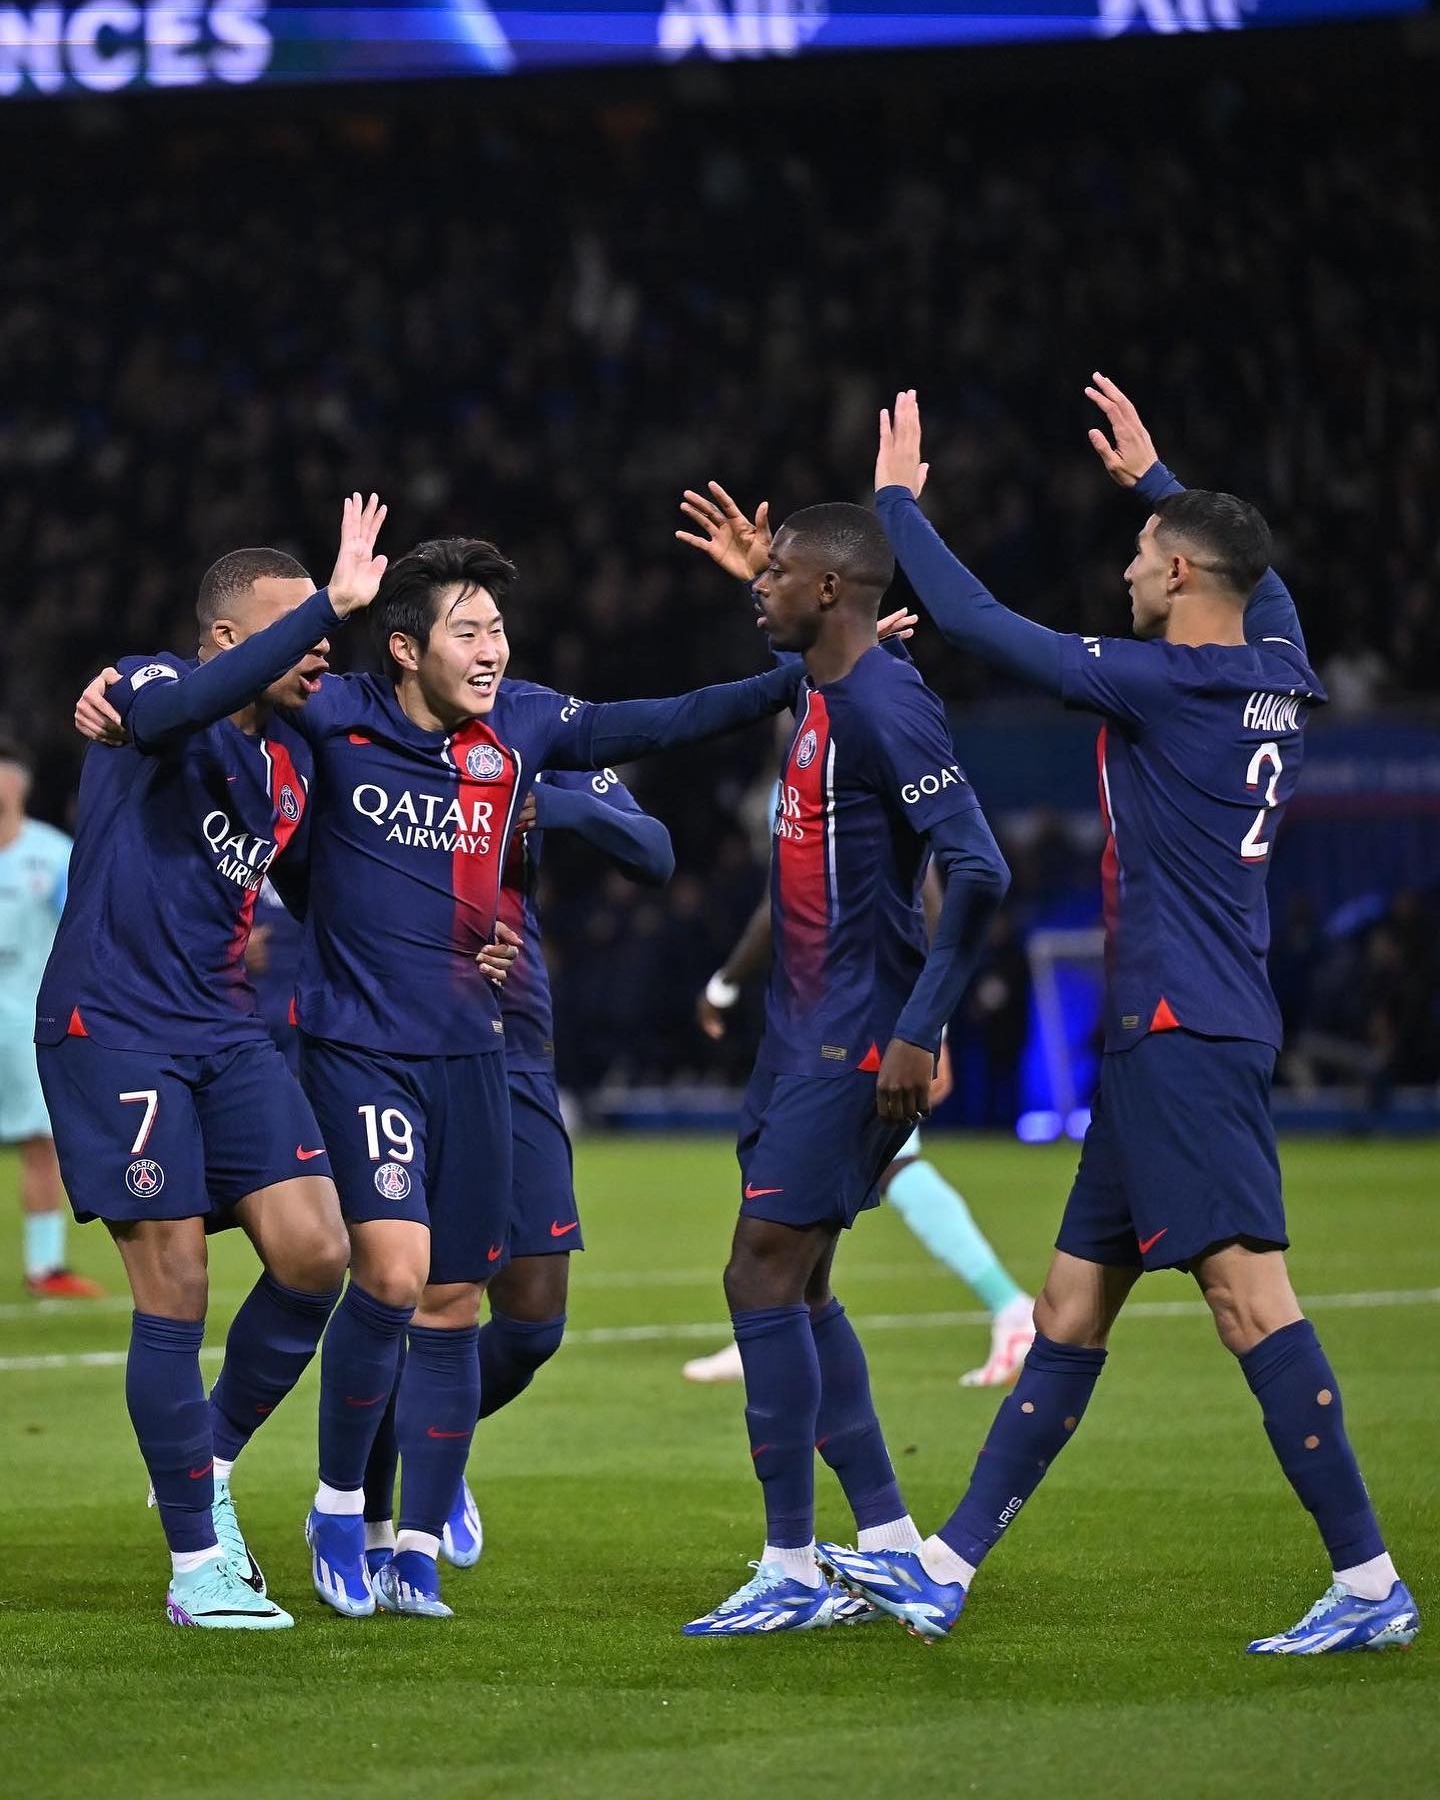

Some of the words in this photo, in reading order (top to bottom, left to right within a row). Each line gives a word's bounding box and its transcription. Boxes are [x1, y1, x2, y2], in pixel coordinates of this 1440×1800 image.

[591, 767, 618, 794] GO
[901, 765, 965, 804] GOAT
[1241, 742, 1282, 862] 2
[352, 784, 493, 833] QATAR
[386, 823, 491, 855] AIRWAYS
[119, 1089, 159, 1156] 7
[357, 1104, 415, 1163] 19
[130, 1160, 156, 1172] PARIS
